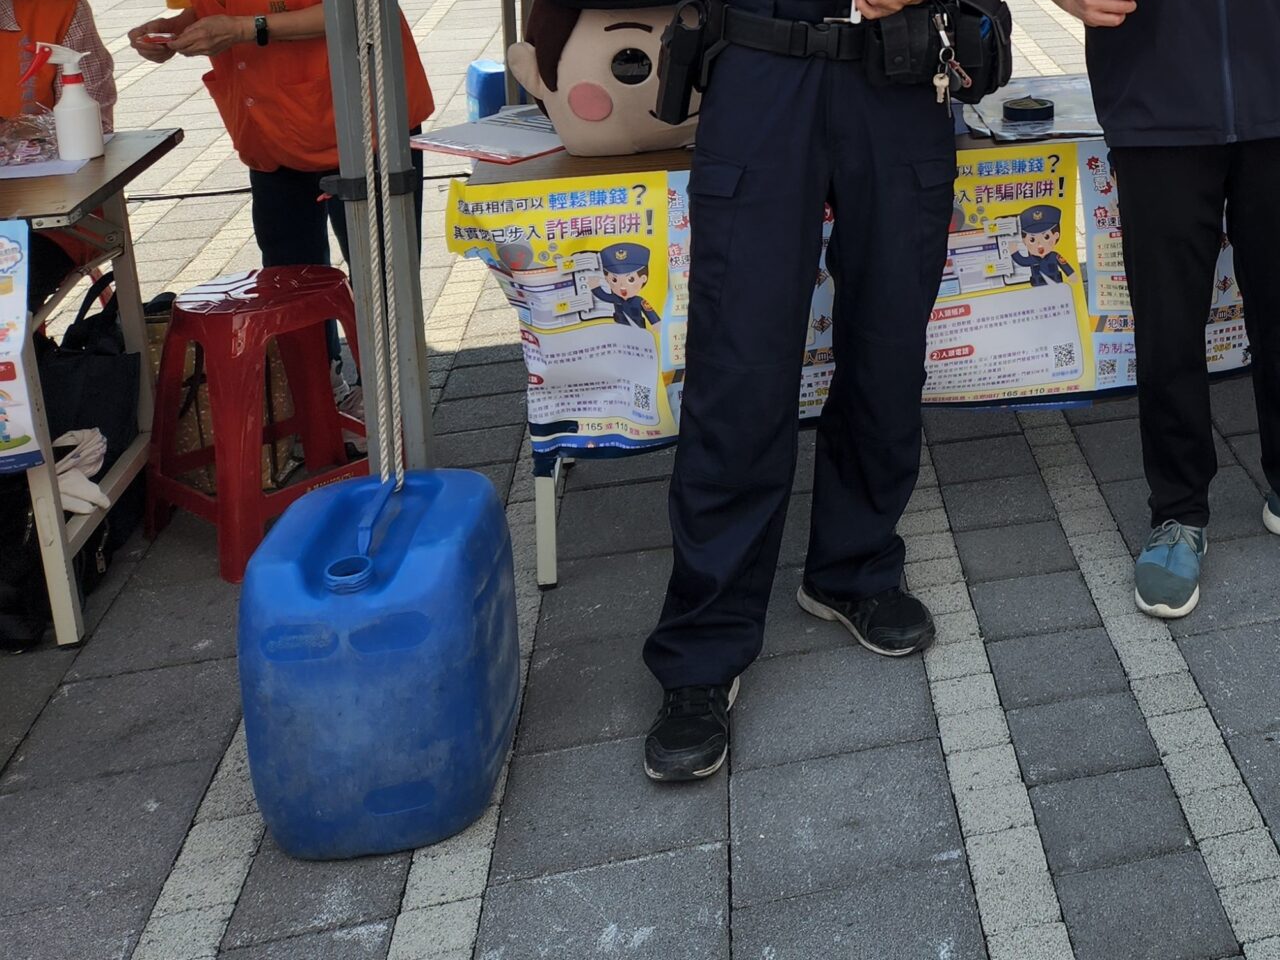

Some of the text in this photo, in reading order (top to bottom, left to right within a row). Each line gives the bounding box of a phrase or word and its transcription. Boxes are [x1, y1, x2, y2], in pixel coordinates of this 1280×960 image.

[1002, 389, 1018, 397] 165
[586, 423, 603, 431] 165
[616, 421, 628, 431] 110
